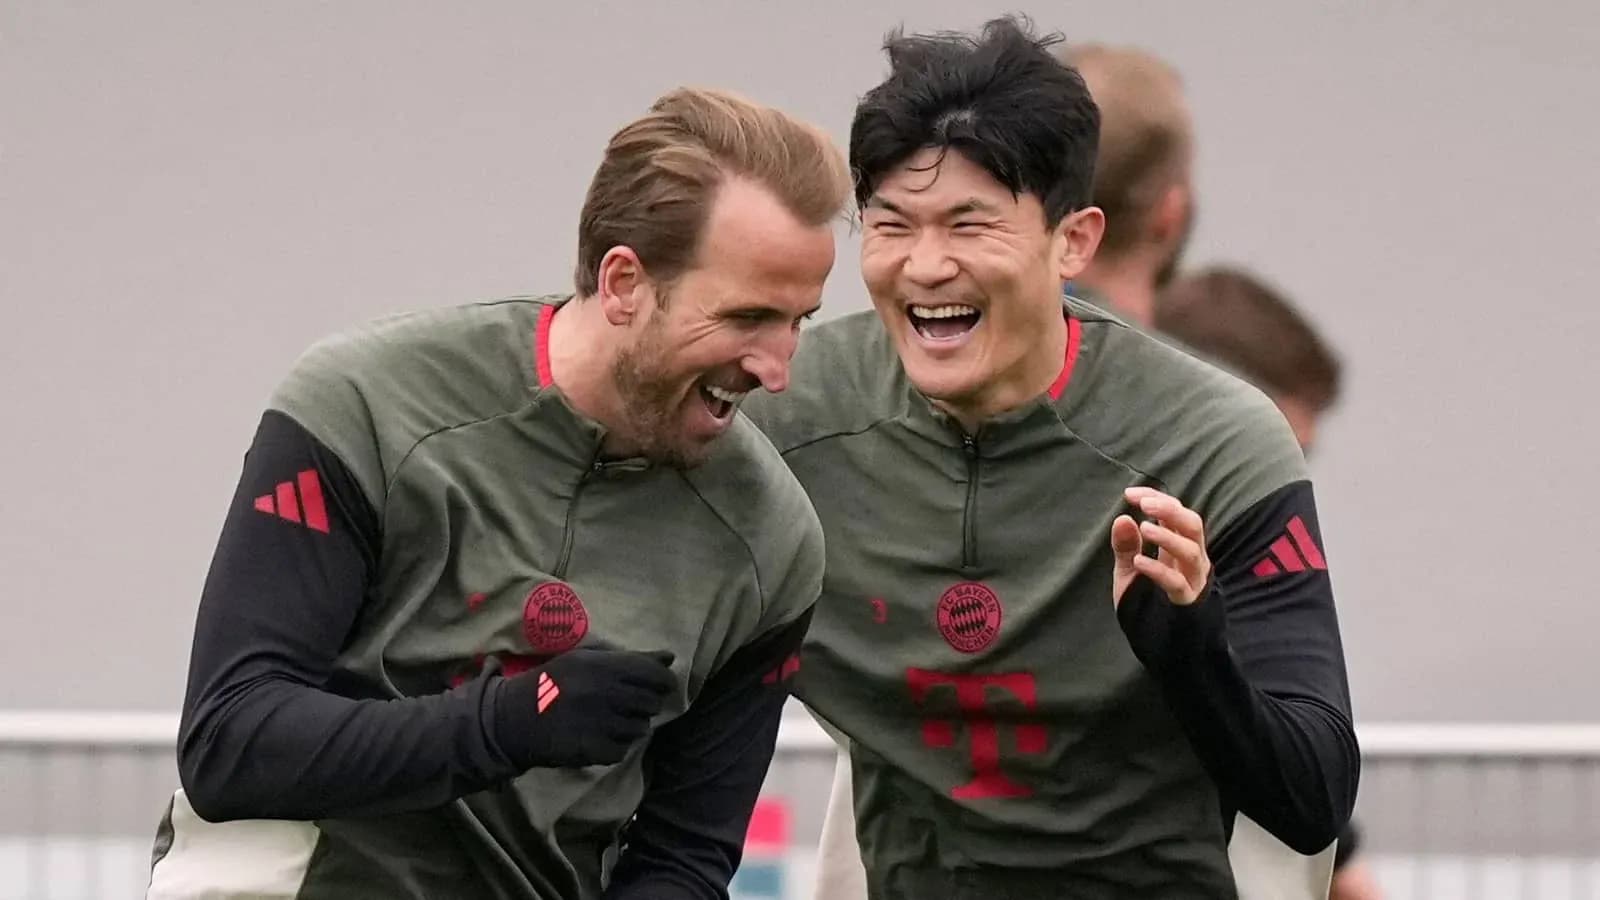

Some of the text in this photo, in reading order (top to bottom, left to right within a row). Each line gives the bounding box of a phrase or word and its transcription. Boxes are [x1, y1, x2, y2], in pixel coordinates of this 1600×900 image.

[549, 587, 585, 620] BAYERN
[941, 587, 997, 612] FC BAYERN
[942, 625, 994, 650] MÜNCHEN
